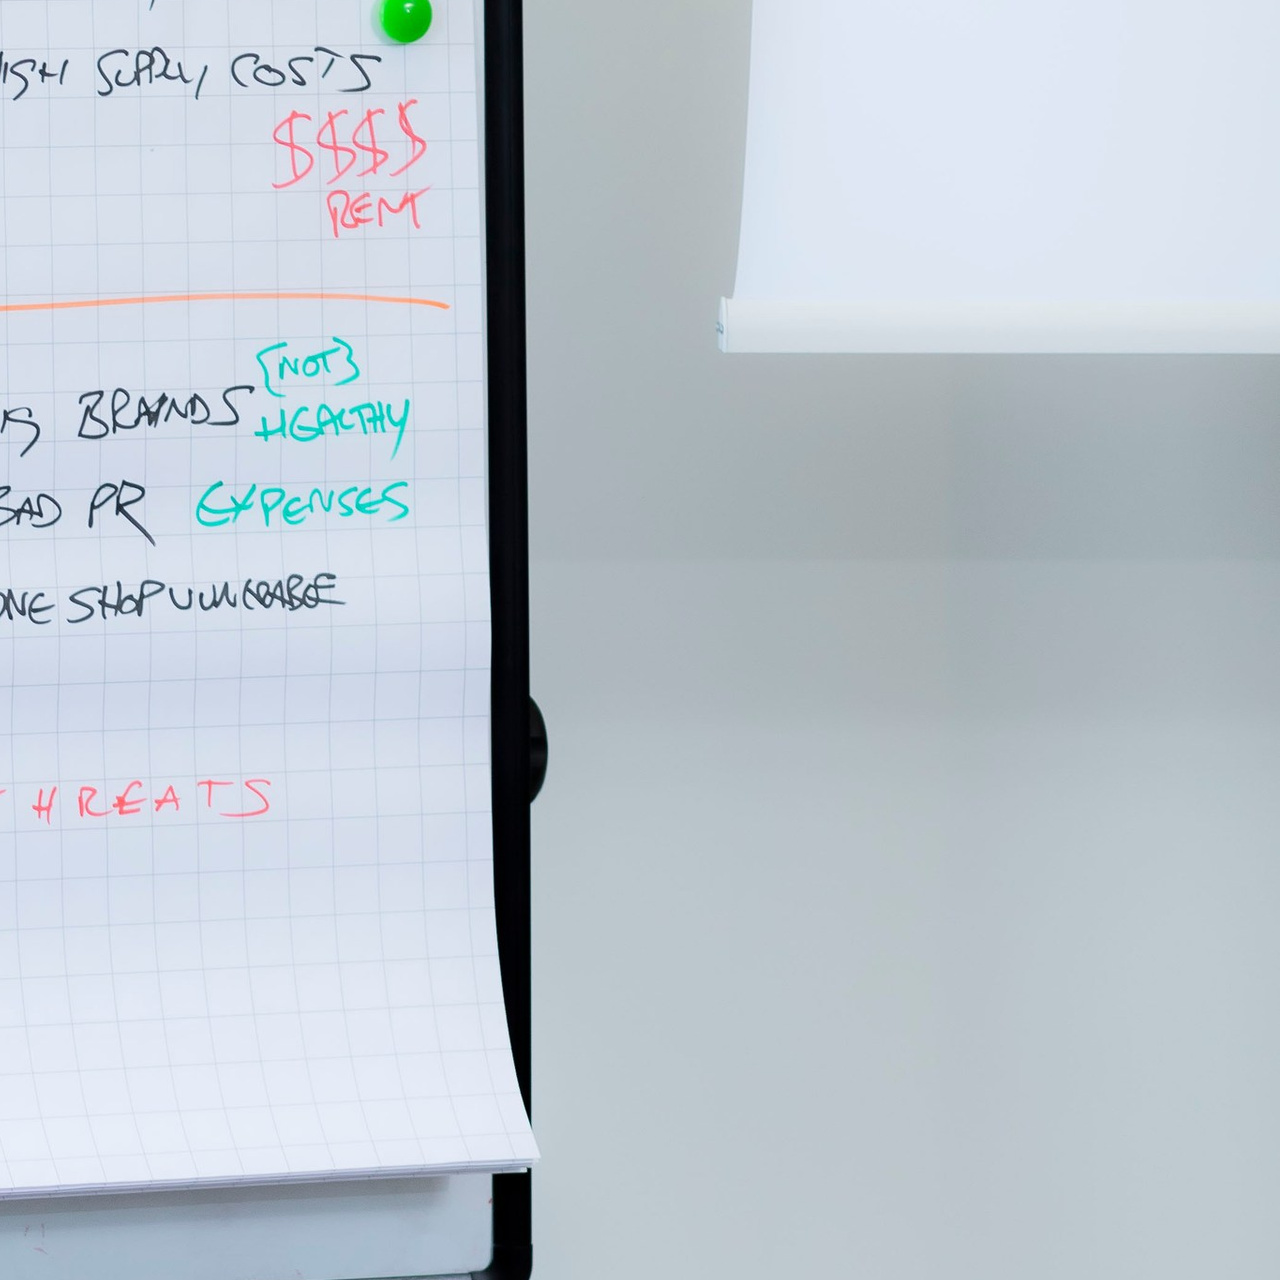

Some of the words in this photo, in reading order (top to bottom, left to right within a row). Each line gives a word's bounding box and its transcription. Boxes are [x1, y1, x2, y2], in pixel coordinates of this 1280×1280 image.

[230, 46, 383, 93] COSTS
[326, 189, 430, 238] RENT
[87, 479, 156, 547] PR
[195, 480, 410, 528] EXPENSES
[66, 579, 166, 624] SHOP
